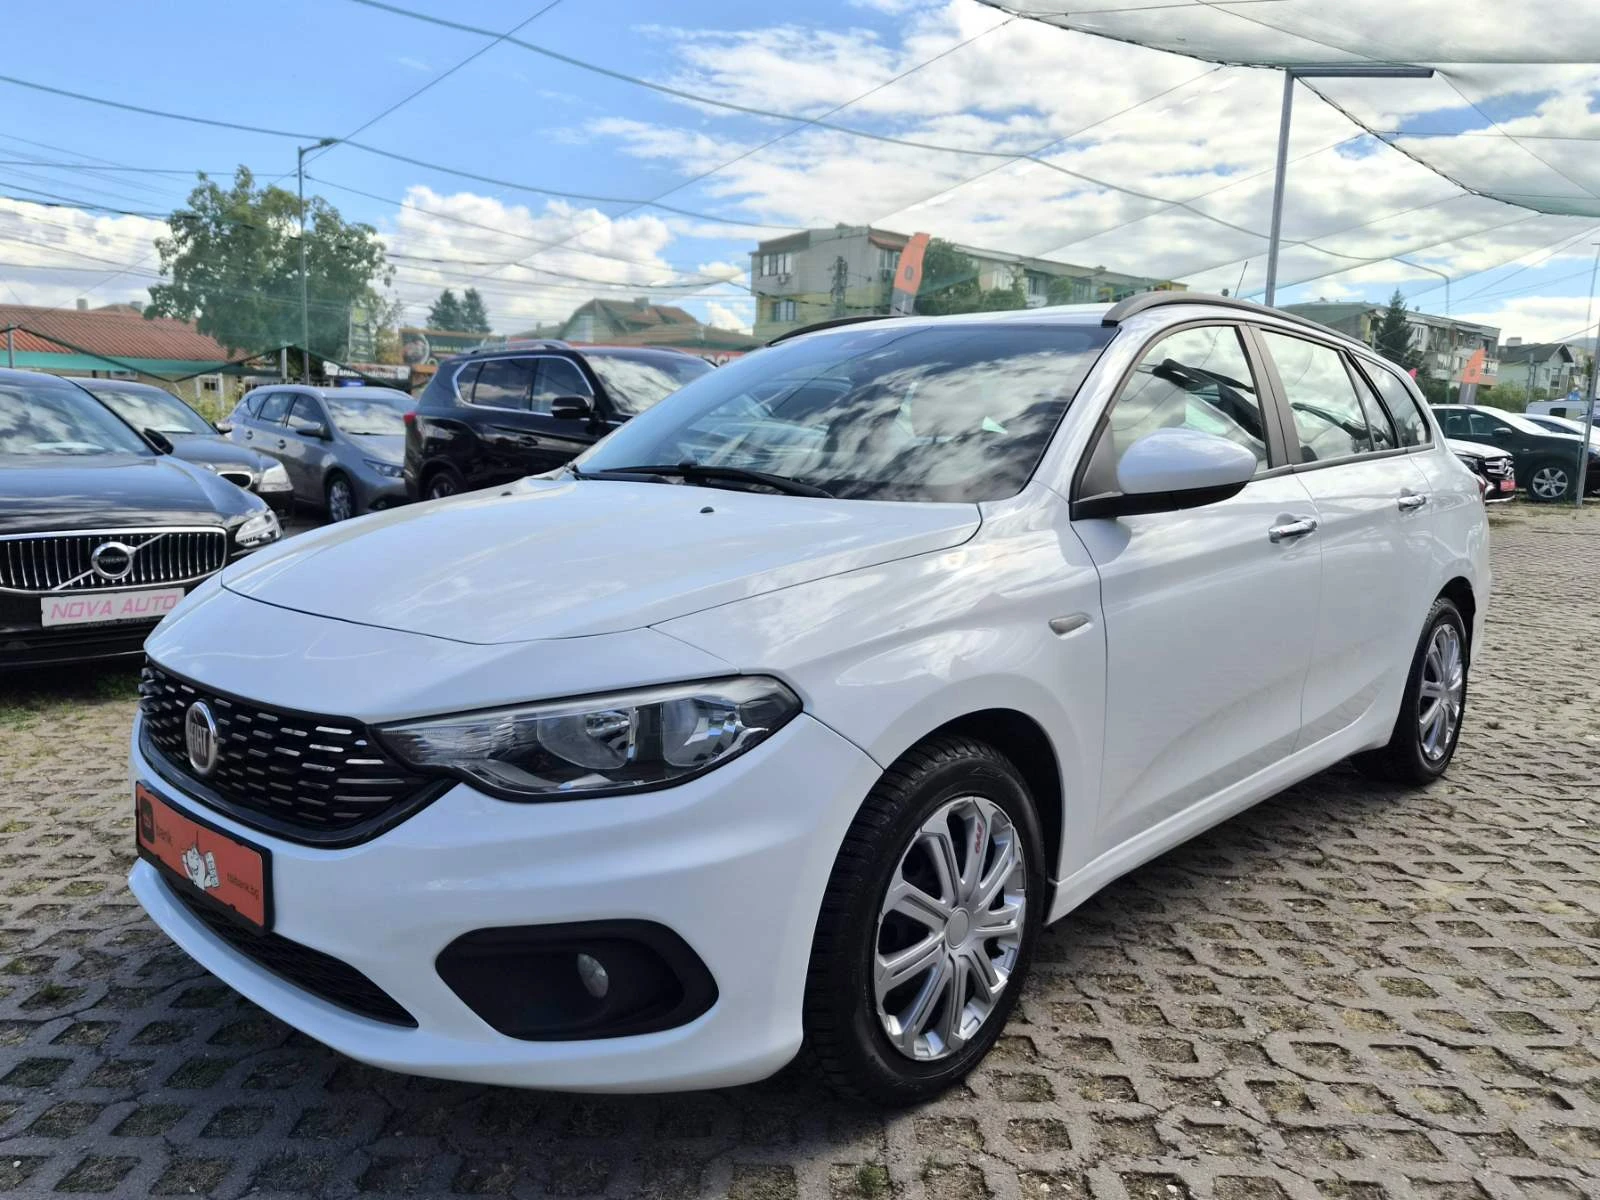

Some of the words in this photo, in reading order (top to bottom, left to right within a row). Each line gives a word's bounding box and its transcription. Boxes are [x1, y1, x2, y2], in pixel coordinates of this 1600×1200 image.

[51, 600, 112, 620] NOVA
[120, 593, 178, 613] AUTO
[189, 721, 208, 758] FIAT
